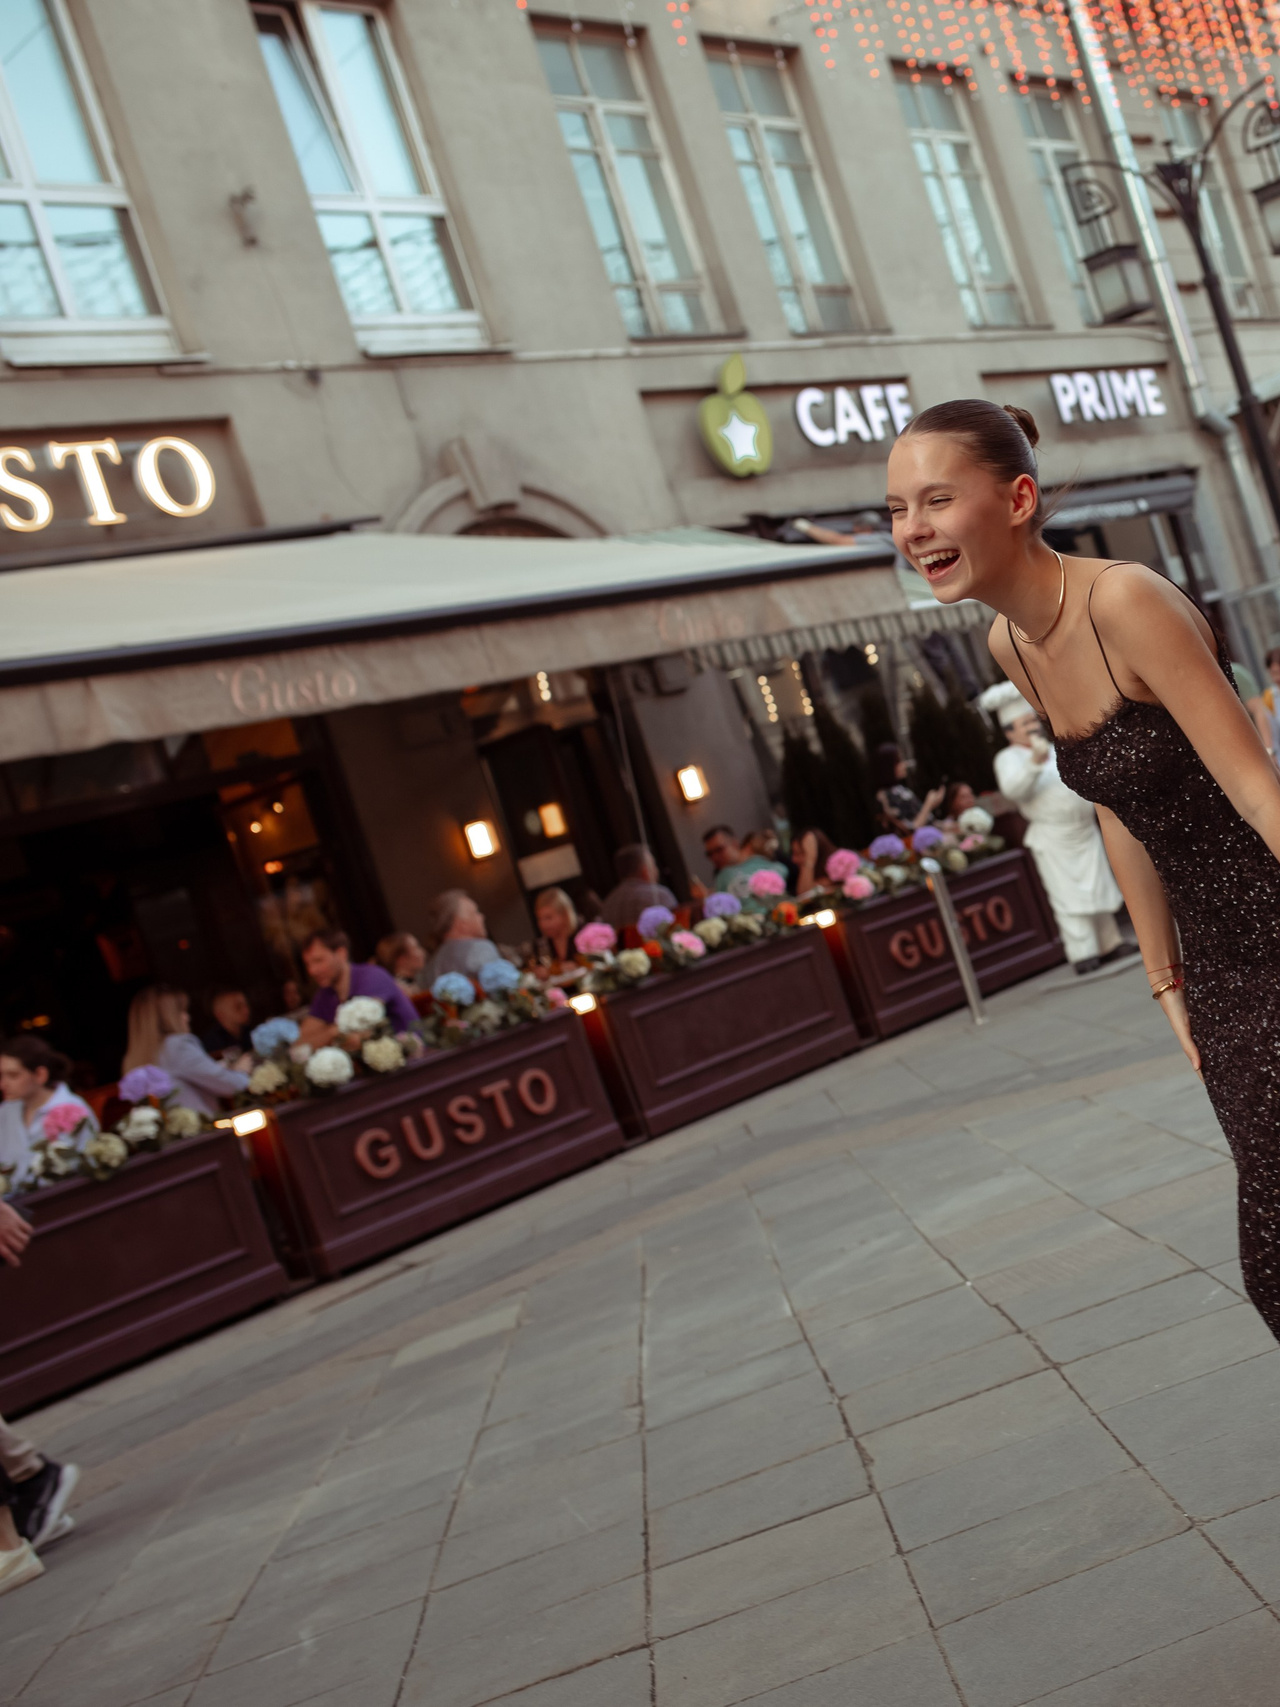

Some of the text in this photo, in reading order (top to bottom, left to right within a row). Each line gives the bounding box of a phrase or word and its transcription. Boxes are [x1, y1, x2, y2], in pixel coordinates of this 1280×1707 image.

[1050, 368, 1167, 424] PRIME
[0, 436, 216, 532] STO
[889, 896, 1014, 969] GUTO
[354, 1067, 558, 1179] GUSTO
